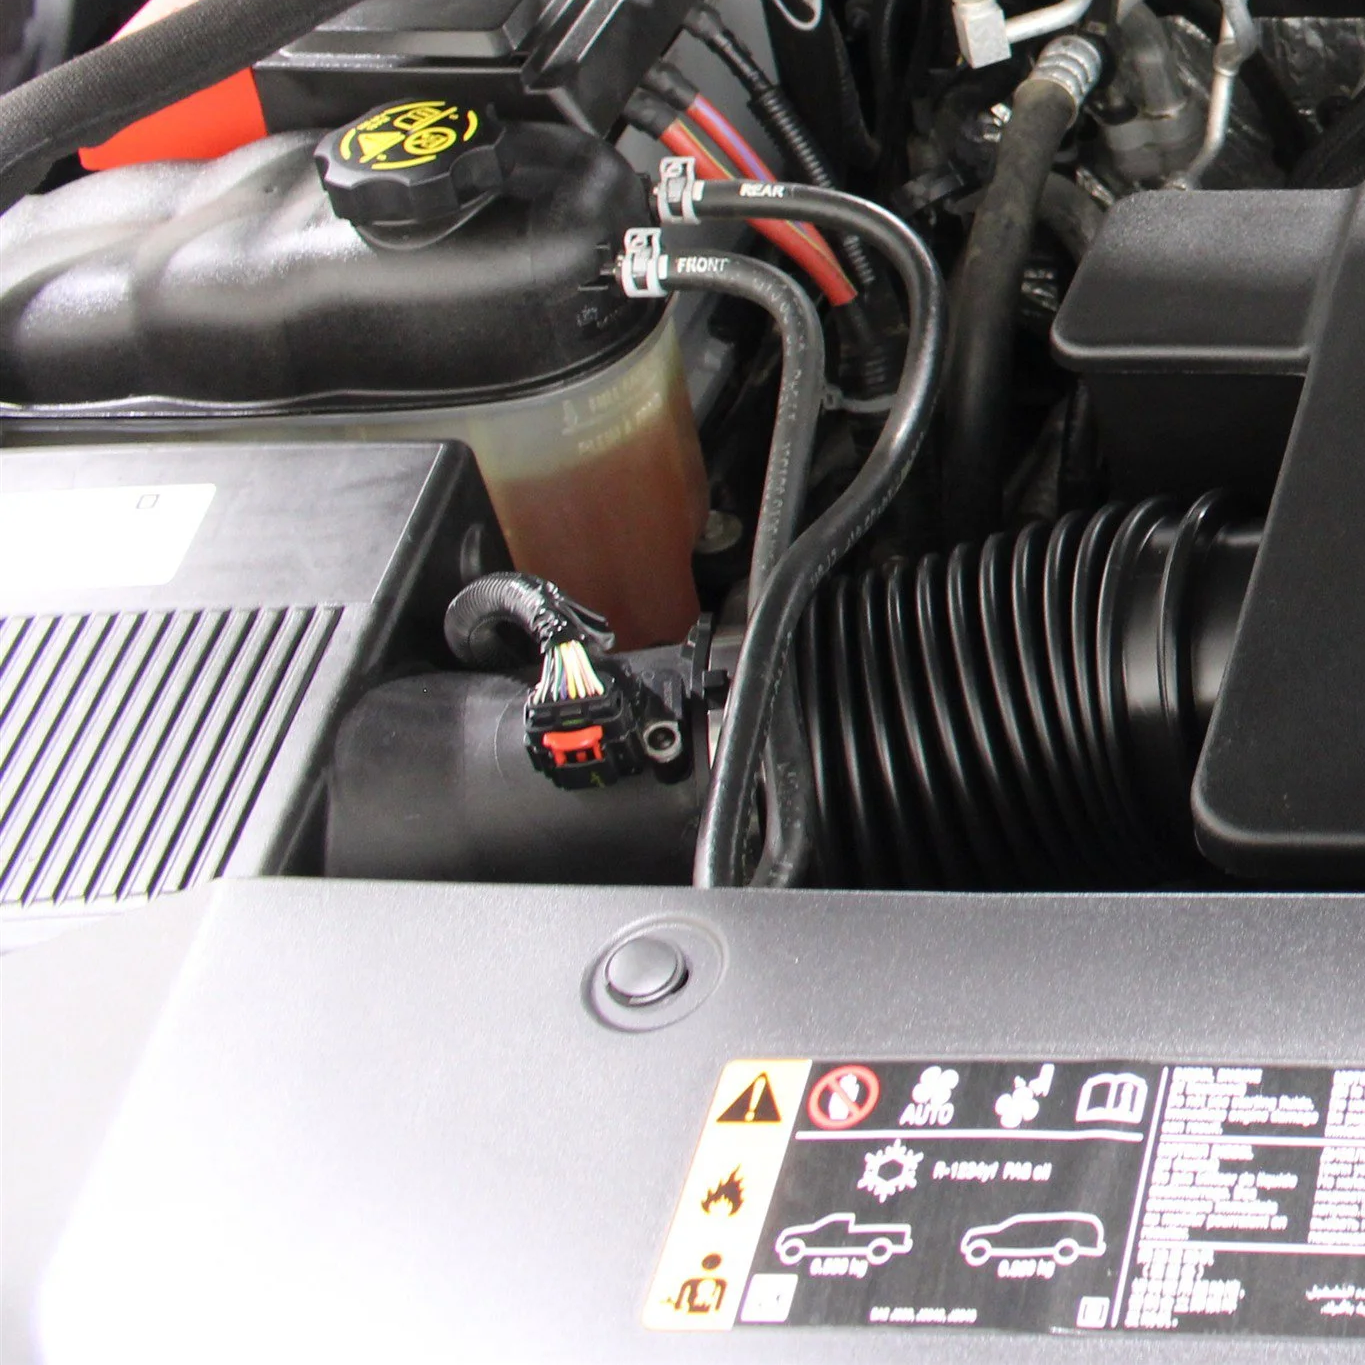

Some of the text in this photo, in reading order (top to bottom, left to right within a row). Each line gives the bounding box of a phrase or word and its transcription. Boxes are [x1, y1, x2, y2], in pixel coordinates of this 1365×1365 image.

[739, 183, 784, 198] REAR
[676, 256, 729, 273] FRONT
[899, 1103, 955, 1126] AUTO
